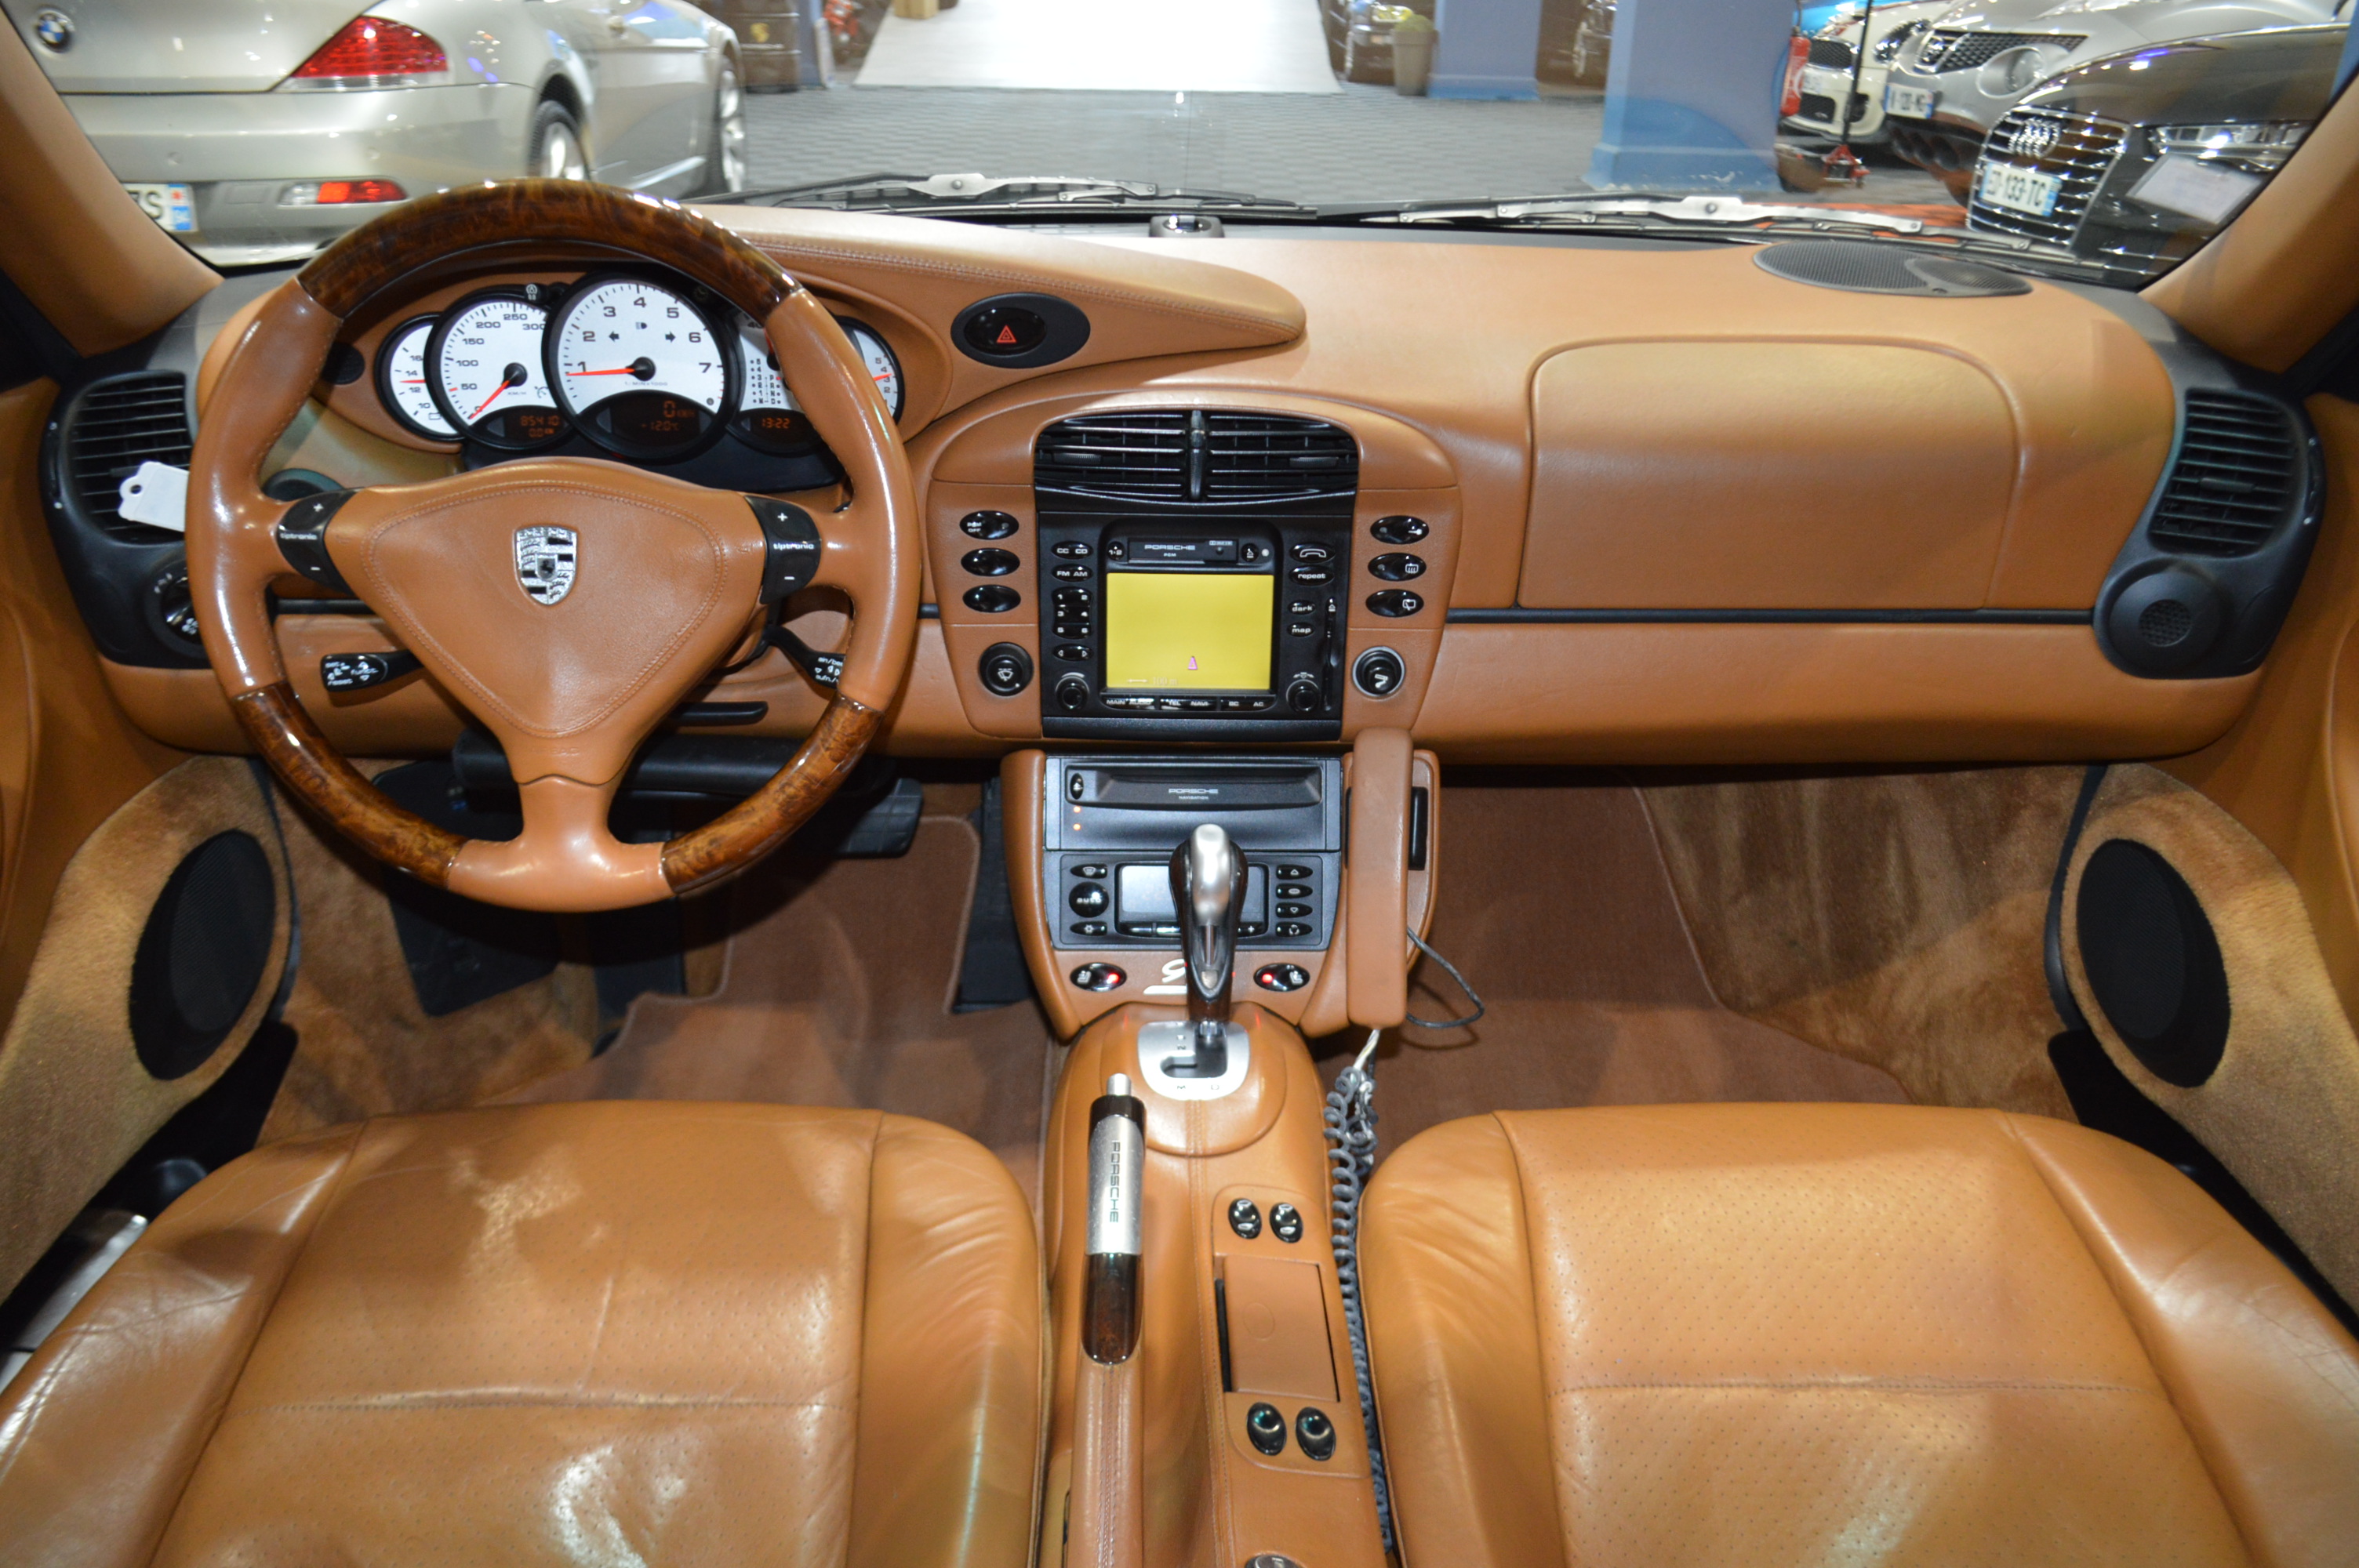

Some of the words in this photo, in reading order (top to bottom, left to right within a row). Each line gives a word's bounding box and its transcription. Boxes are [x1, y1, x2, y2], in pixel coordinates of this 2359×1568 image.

[634, 296, 647, 308] 4
[603, 306, 616, 318] 3
[667, 307, 680, 318] 5
[582, 331, 596, 343] 2
[689, 332, 702, 343] 6
[577, 361, 587, 372] 1
[698, 362, 712, 374] 7
[663, 399, 676, 419] 0
[761, 417, 791, 429] 13:22
[772, 542, 816, 551] tiptronic
[1297, 572, 1326, 580] repeat
[1152, 677, 1169, 685] 100
[1109, 1142, 1121, 1223] PORSCHE
